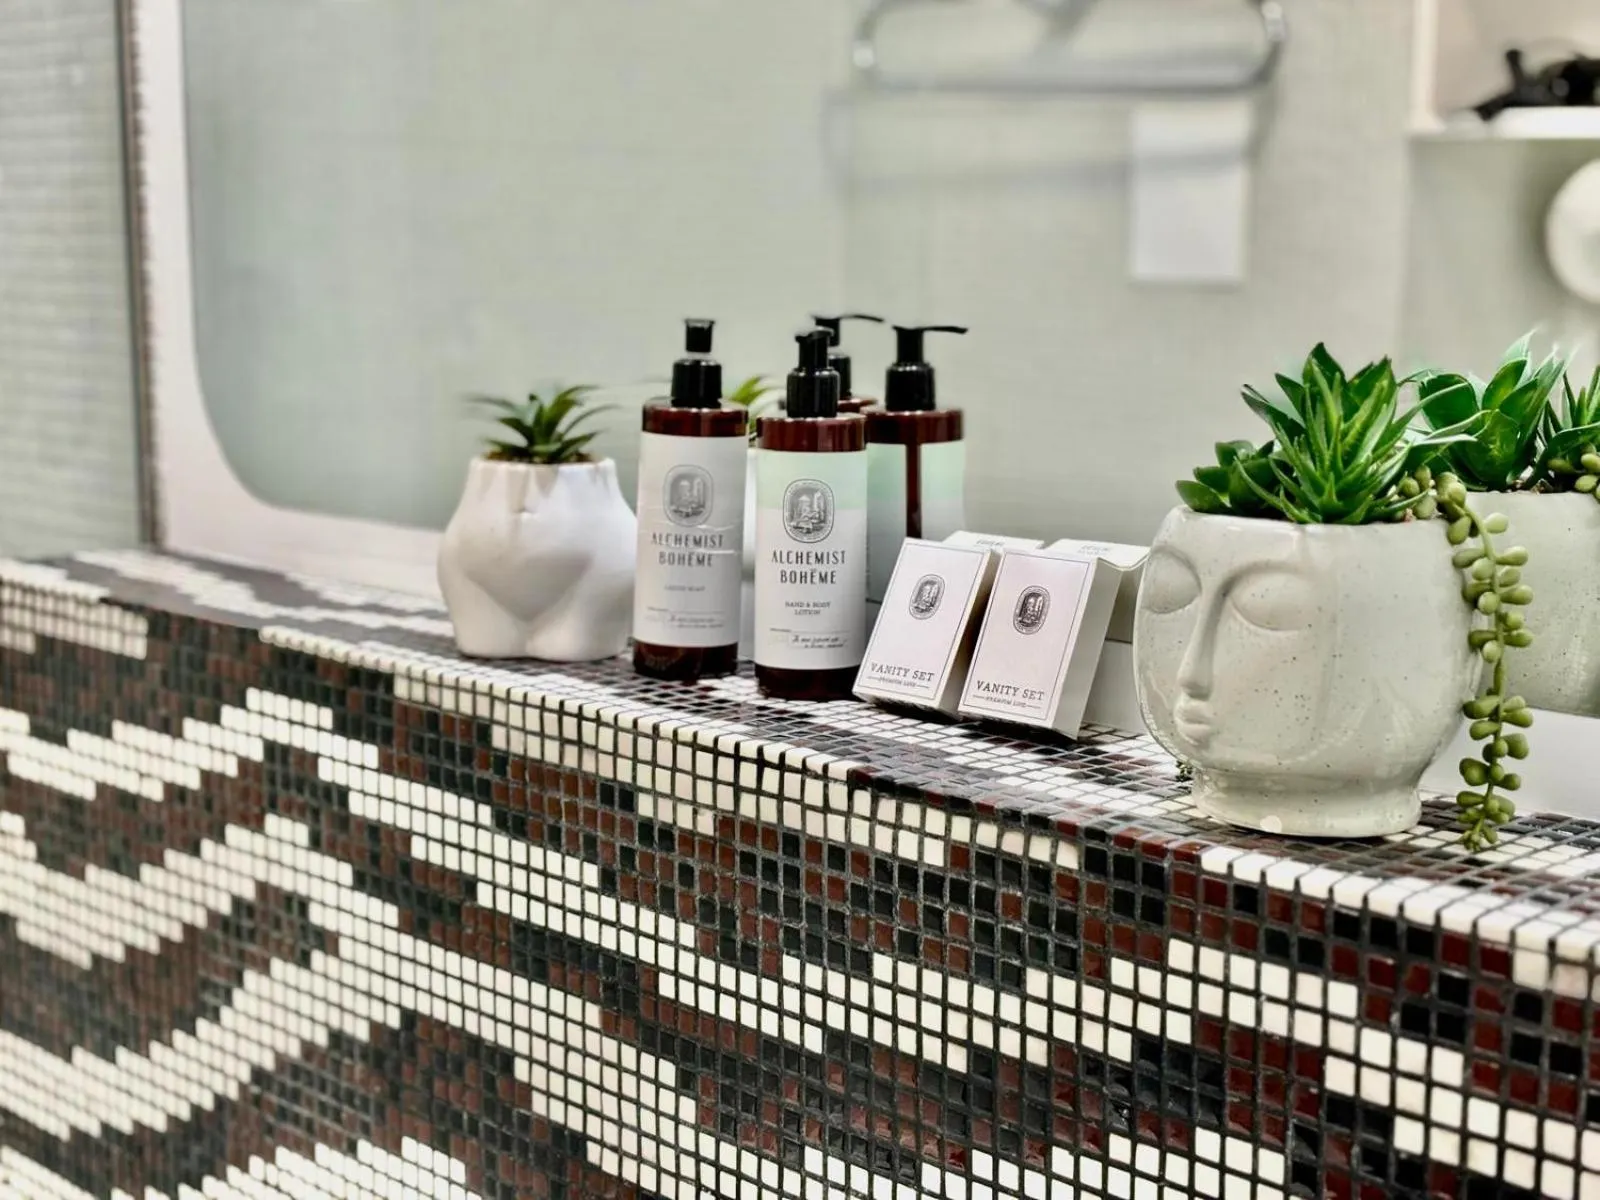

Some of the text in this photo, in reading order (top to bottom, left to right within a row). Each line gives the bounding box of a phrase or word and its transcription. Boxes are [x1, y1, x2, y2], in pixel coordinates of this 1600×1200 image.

[651, 532, 724, 549] ALCHEMIST
[771, 550, 846, 565] ALCHEMIST
[871, 662, 935, 682] VANITY SET
[977, 680, 1045, 700] VANITY SET
